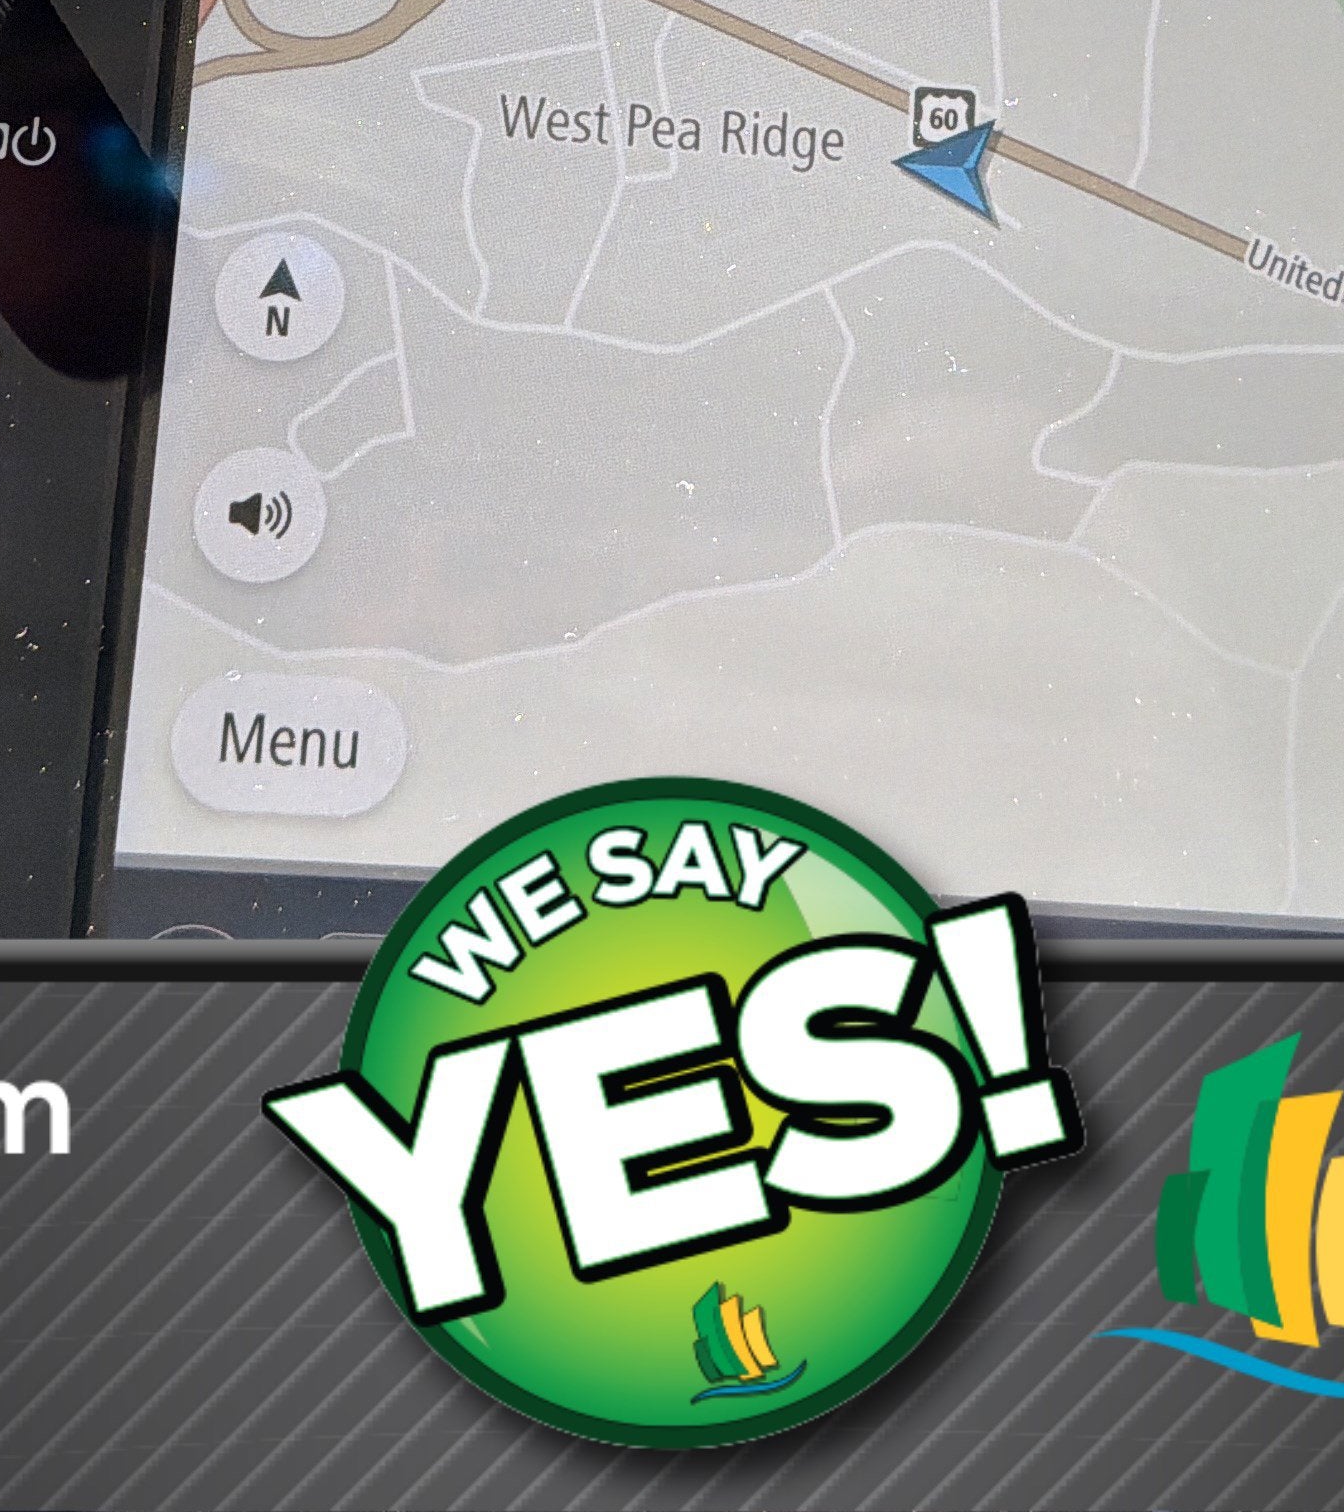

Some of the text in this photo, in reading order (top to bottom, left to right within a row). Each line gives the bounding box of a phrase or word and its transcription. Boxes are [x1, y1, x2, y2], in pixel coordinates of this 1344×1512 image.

[499, 93, 845, 174] West Pea Ridge
[929, 107, 960, 133] 60
[1248, 238, 1344, 302] United
[265, 306, 290, 337] N
[219, 710, 360, 770] Menu
